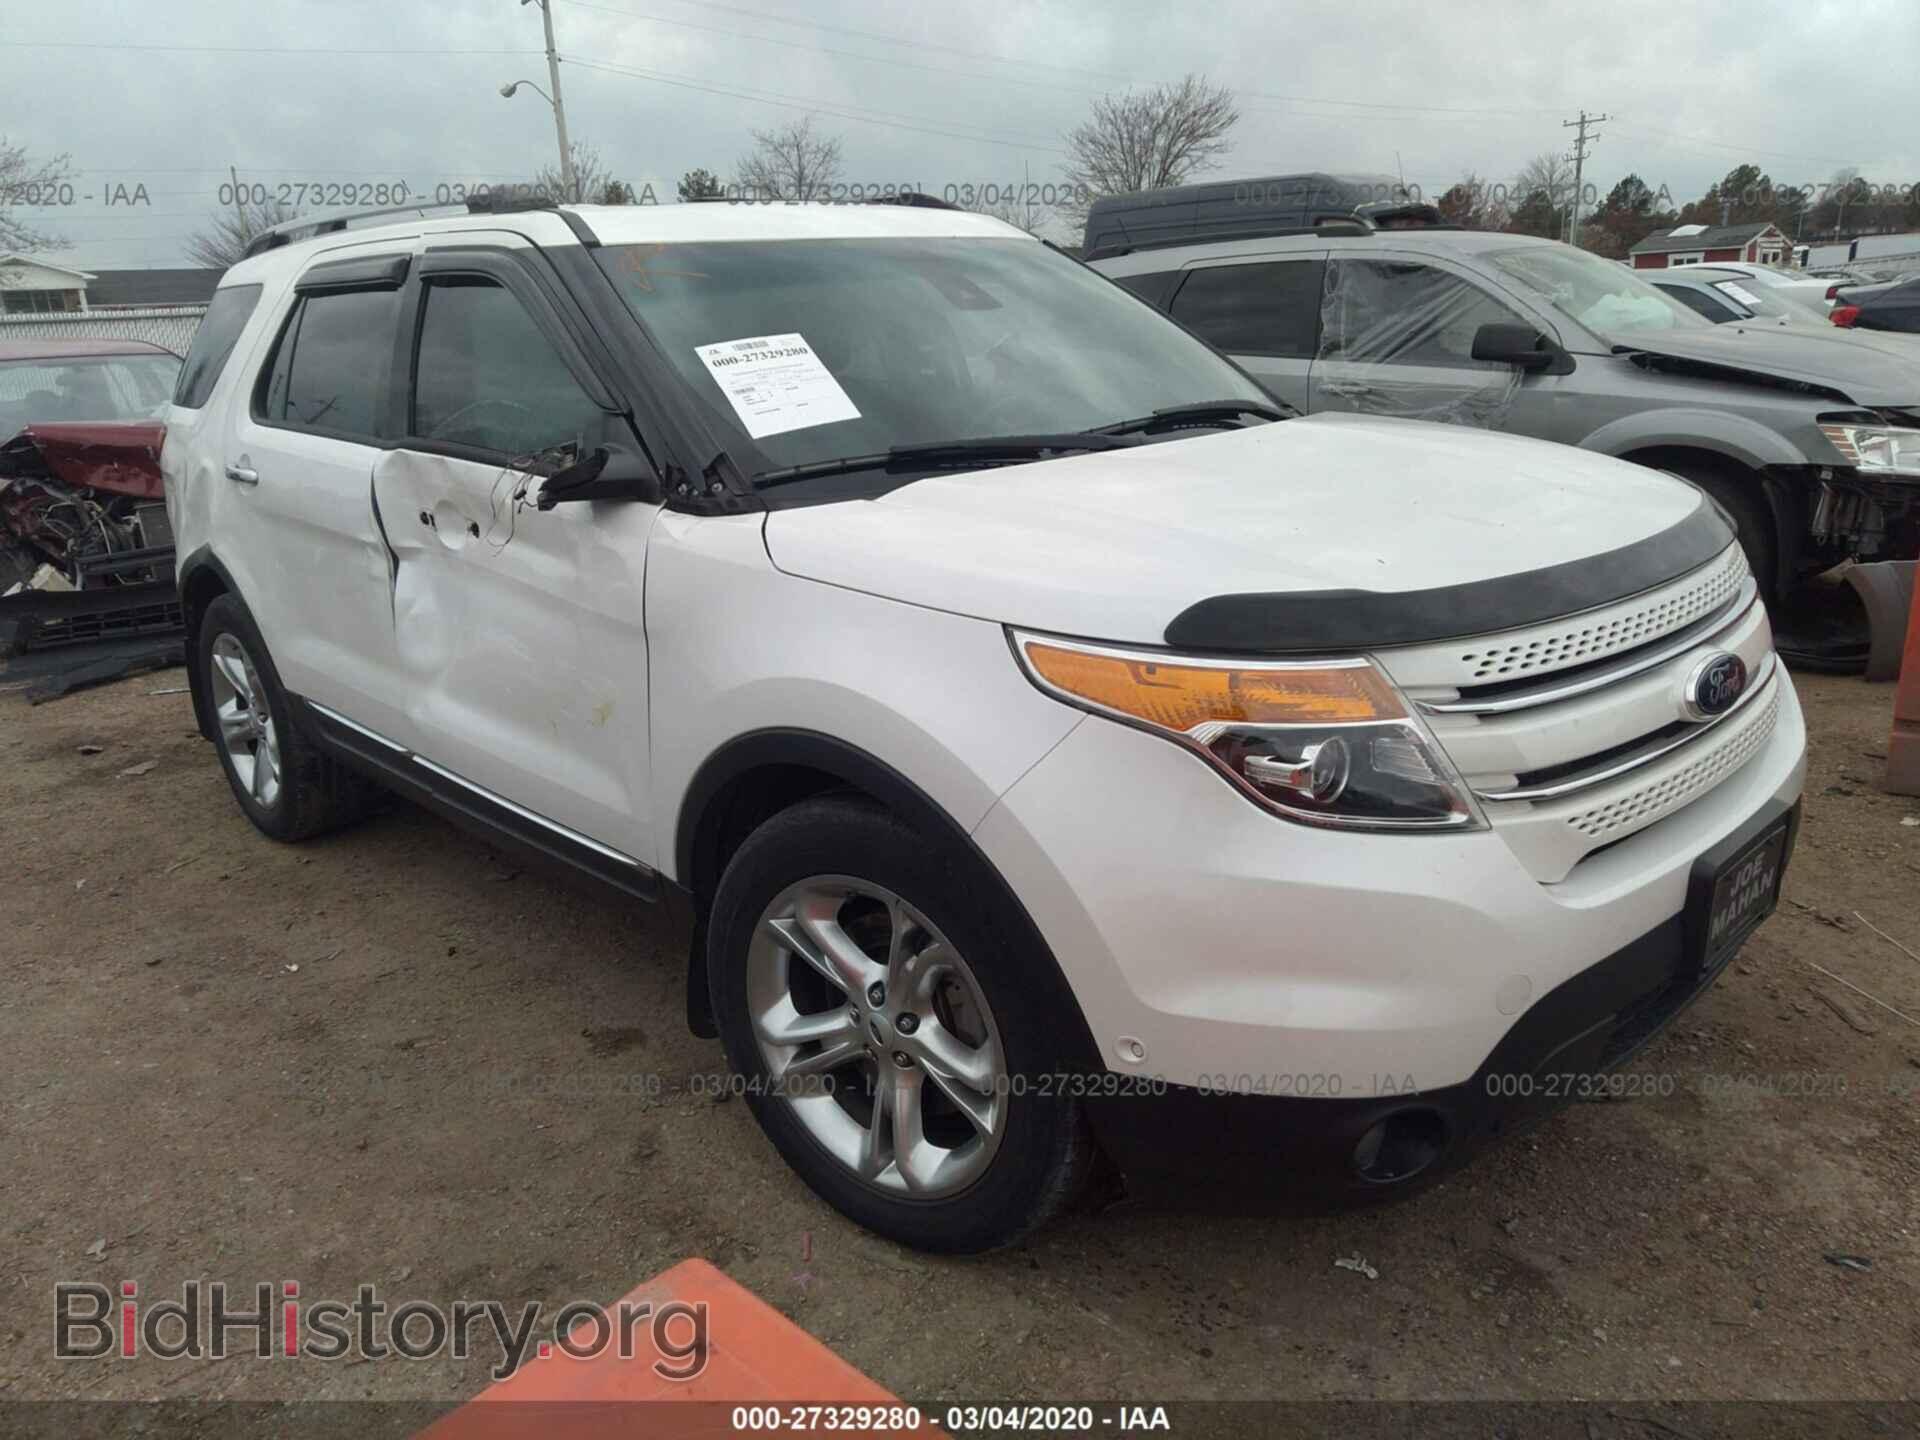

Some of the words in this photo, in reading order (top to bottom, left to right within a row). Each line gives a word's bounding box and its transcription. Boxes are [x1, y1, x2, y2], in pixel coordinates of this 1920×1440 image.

[712, 347, 809, 368] 000-27329280
[1730, 851, 1766, 897] JOE
[1711, 866, 1775, 940] MAHAN
